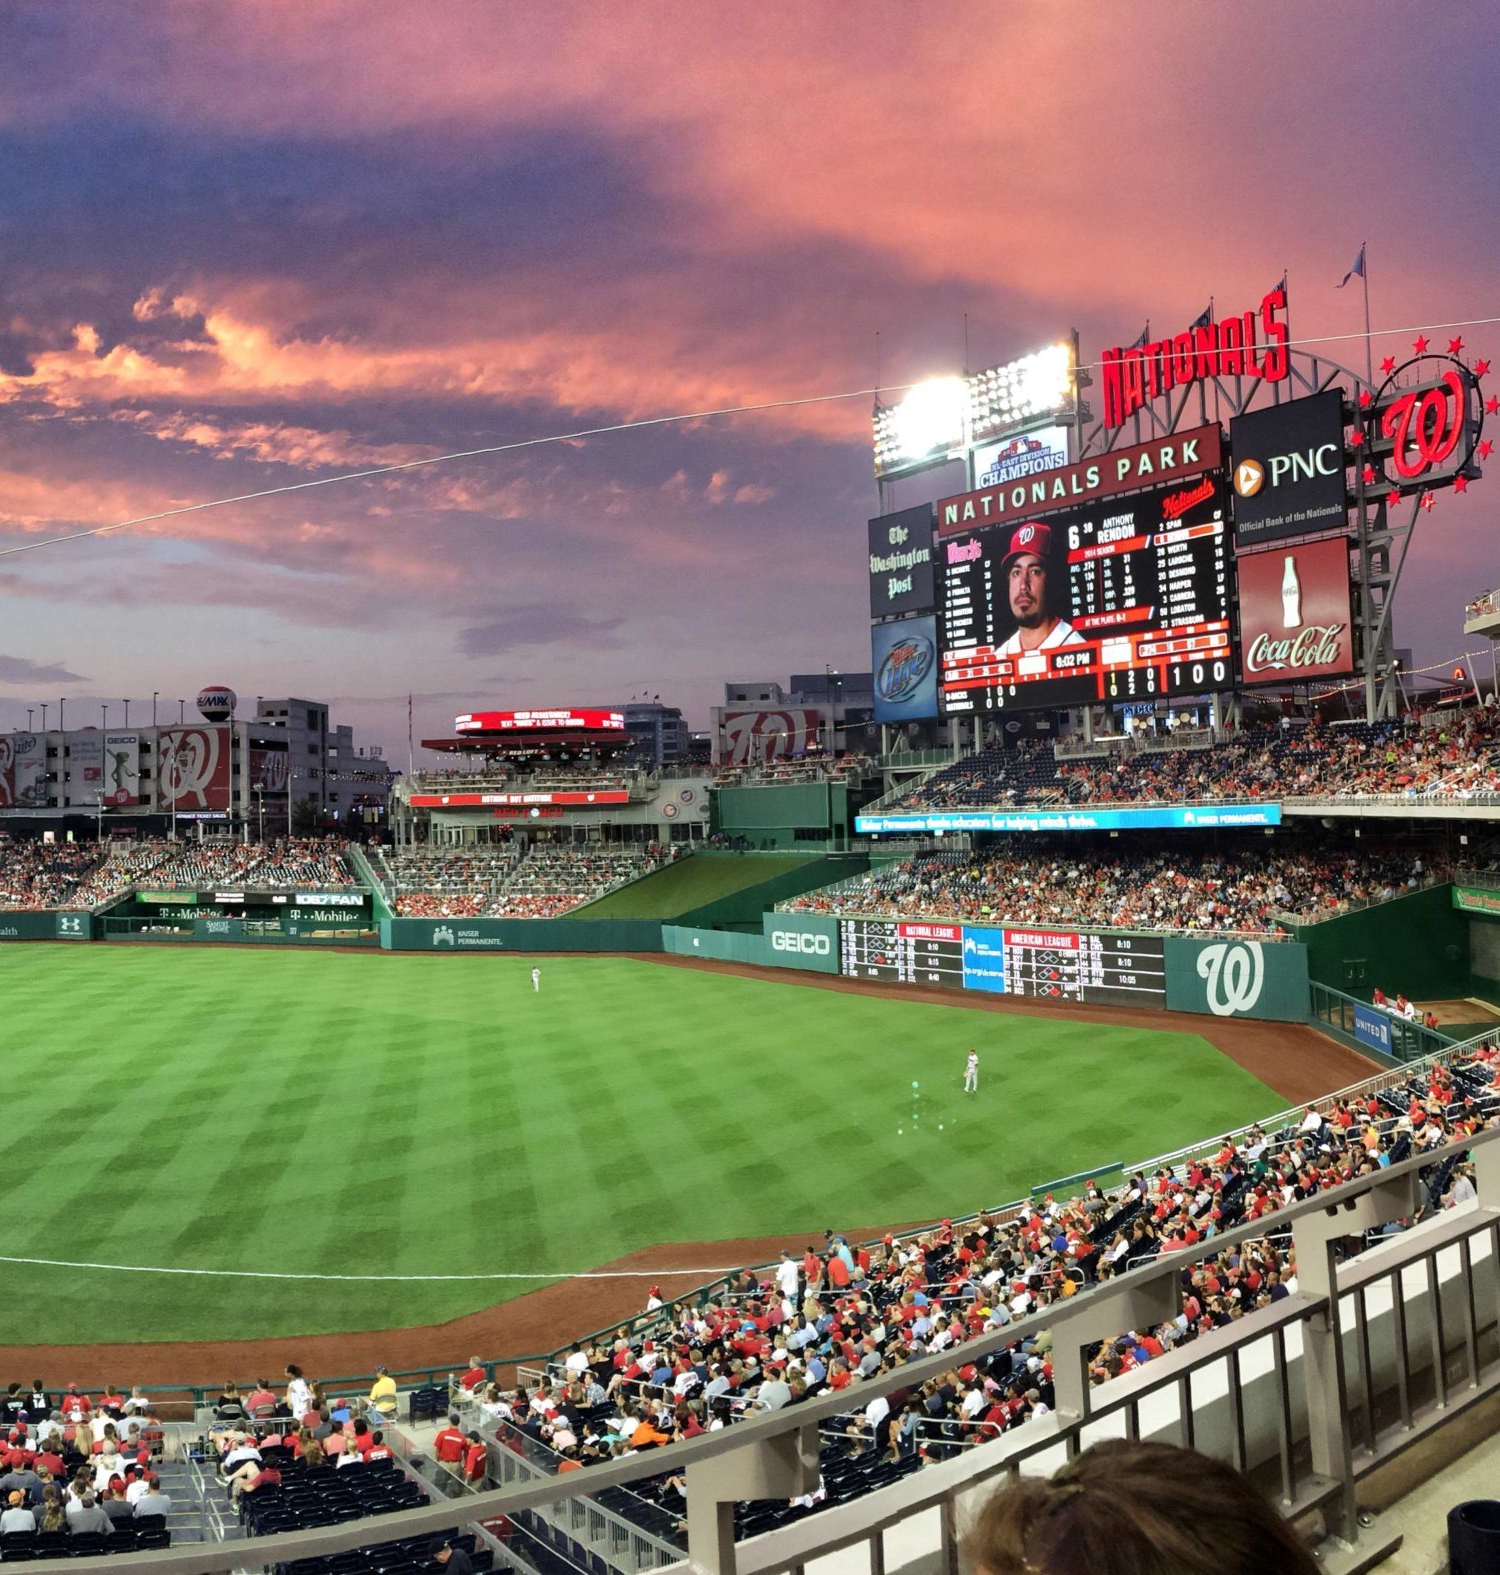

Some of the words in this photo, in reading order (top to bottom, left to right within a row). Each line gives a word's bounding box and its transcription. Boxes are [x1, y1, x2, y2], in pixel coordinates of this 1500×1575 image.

[1102, 289, 1290, 430] NATIONALS
[1382, 371, 1465, 478] W
[1020, 447, 1050, 463] DIVISION
[1268, 443, 1339, 487] PNC
[945, 466, 1099, 525] NATIONALS
[1116, 439, 1199, 481] PARK
[980, 452, 1064, 488] CHAMPIONS
[1163, 477, 1215, 519] Nationals
[1102, 513, 1134, 529] ANTHONY
[1239, 520, 1264, 532] Official
[1265, 517, 1284, 528] Bank
[1285, 513, 1293, 524] of
[1293, 511, 1305, 521] the
[1306, 504, 1342, 519] Nationals
[889, 526, 909, 545] The
[1068, 526, 1079, 550] 6
[1097, 524, 1135, 544] RENDON
[870, 548, 930, 573] Washington
[1167, 543, 1188, 554] WERTH
[1168, 566, 1196, 578] DESMOND
[888, 575, 912, 600] Post
[1169, 579, 1192, 591] HARPER
[1171, 614, 1204, 627] STRASBURG
[1247, 623, 1344, 672] Coca-Cola
[1056, 655, 1075, 668] 8:02
[1076, 652, 1090, 665] PM
[997, 685, 1004, 696] 0
[1009, 685, 1016, 696] 0
[1128, 670, 1135, 682] 2
[1147, 668, 1154, 680] 0
[1173, 667, 1180, 686] 1
[1193, 664, 1204, 684] 0
[1213, 662, 1225, 682] 0
[986, 698, 992, 709] 0
[997, 697, 1004, 707] 0
[1110, 684, 1118, 696] 0
[1128, 683, 1135, 695] 2
[1147, 680, 1155, 692] 0
[107, 736, 137, 744] GEICO
[331, 894, 364, 906] FAN
[206, 920, 231, 929] SAMUEL
[906, 926, 932, 936] NATIONAL
[772, 931, 830, 955] GEICO
[1011, 933, 1043, 946] AMERICAN
[1196, 941, 1265, 1016] W
[1355, 1018, 1380, 1038] UNITED
